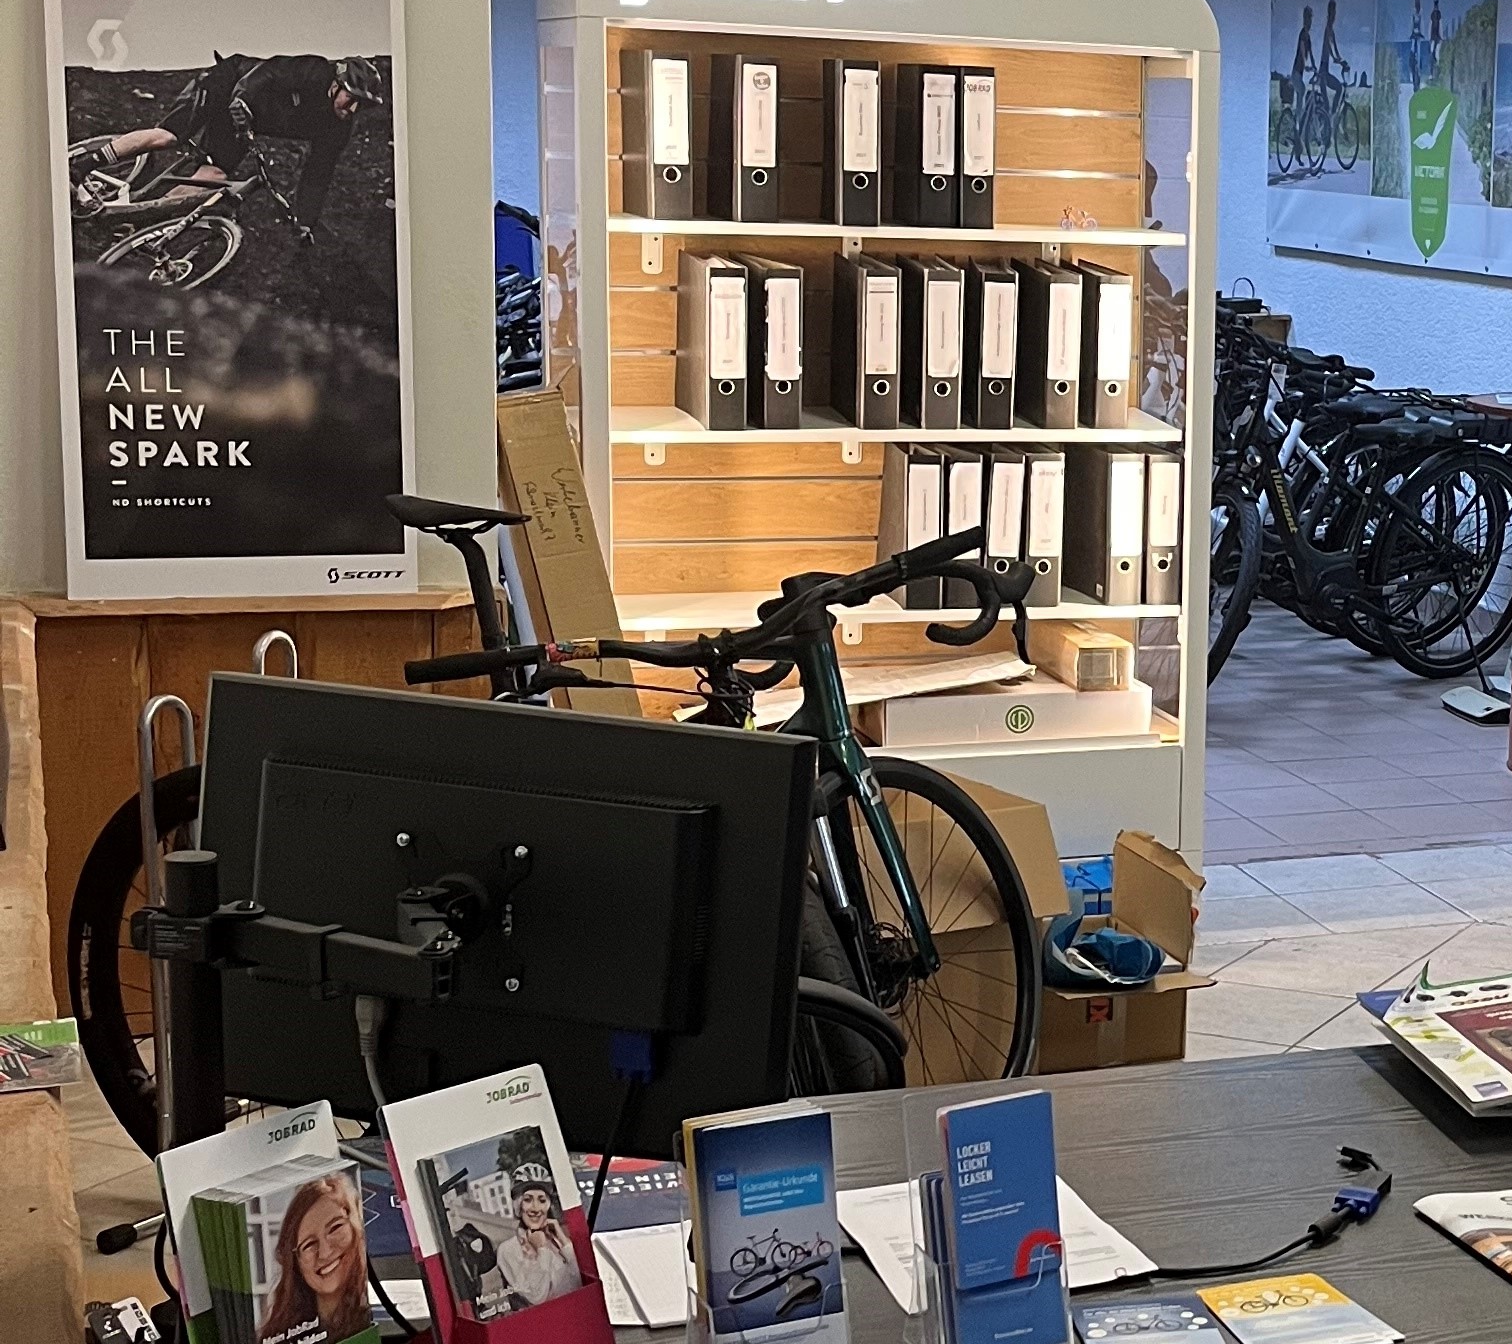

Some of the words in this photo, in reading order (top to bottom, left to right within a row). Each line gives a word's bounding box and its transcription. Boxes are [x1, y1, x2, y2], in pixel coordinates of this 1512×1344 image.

[103, 328, 185, 356] THE
[105, 366, 182, 393] ALL
[109, 404, 205, 430] NEW
[109, 440, 252, 467] SPARK
[112, 498, 130, 507] NO
[136, 497, 212, 507] SHORTCUTS
[341, 569, 406, 580] SCOTT
[486, 1082, 530, 1104] JOBRAD
[267, 1119, 316, 1144] JOBRAD
[957, 1141, 991, 1159] LOCKER
[958, 1156, 988, 1173] LEICHT
[959, 1169, 993, 1188] LEASEN
